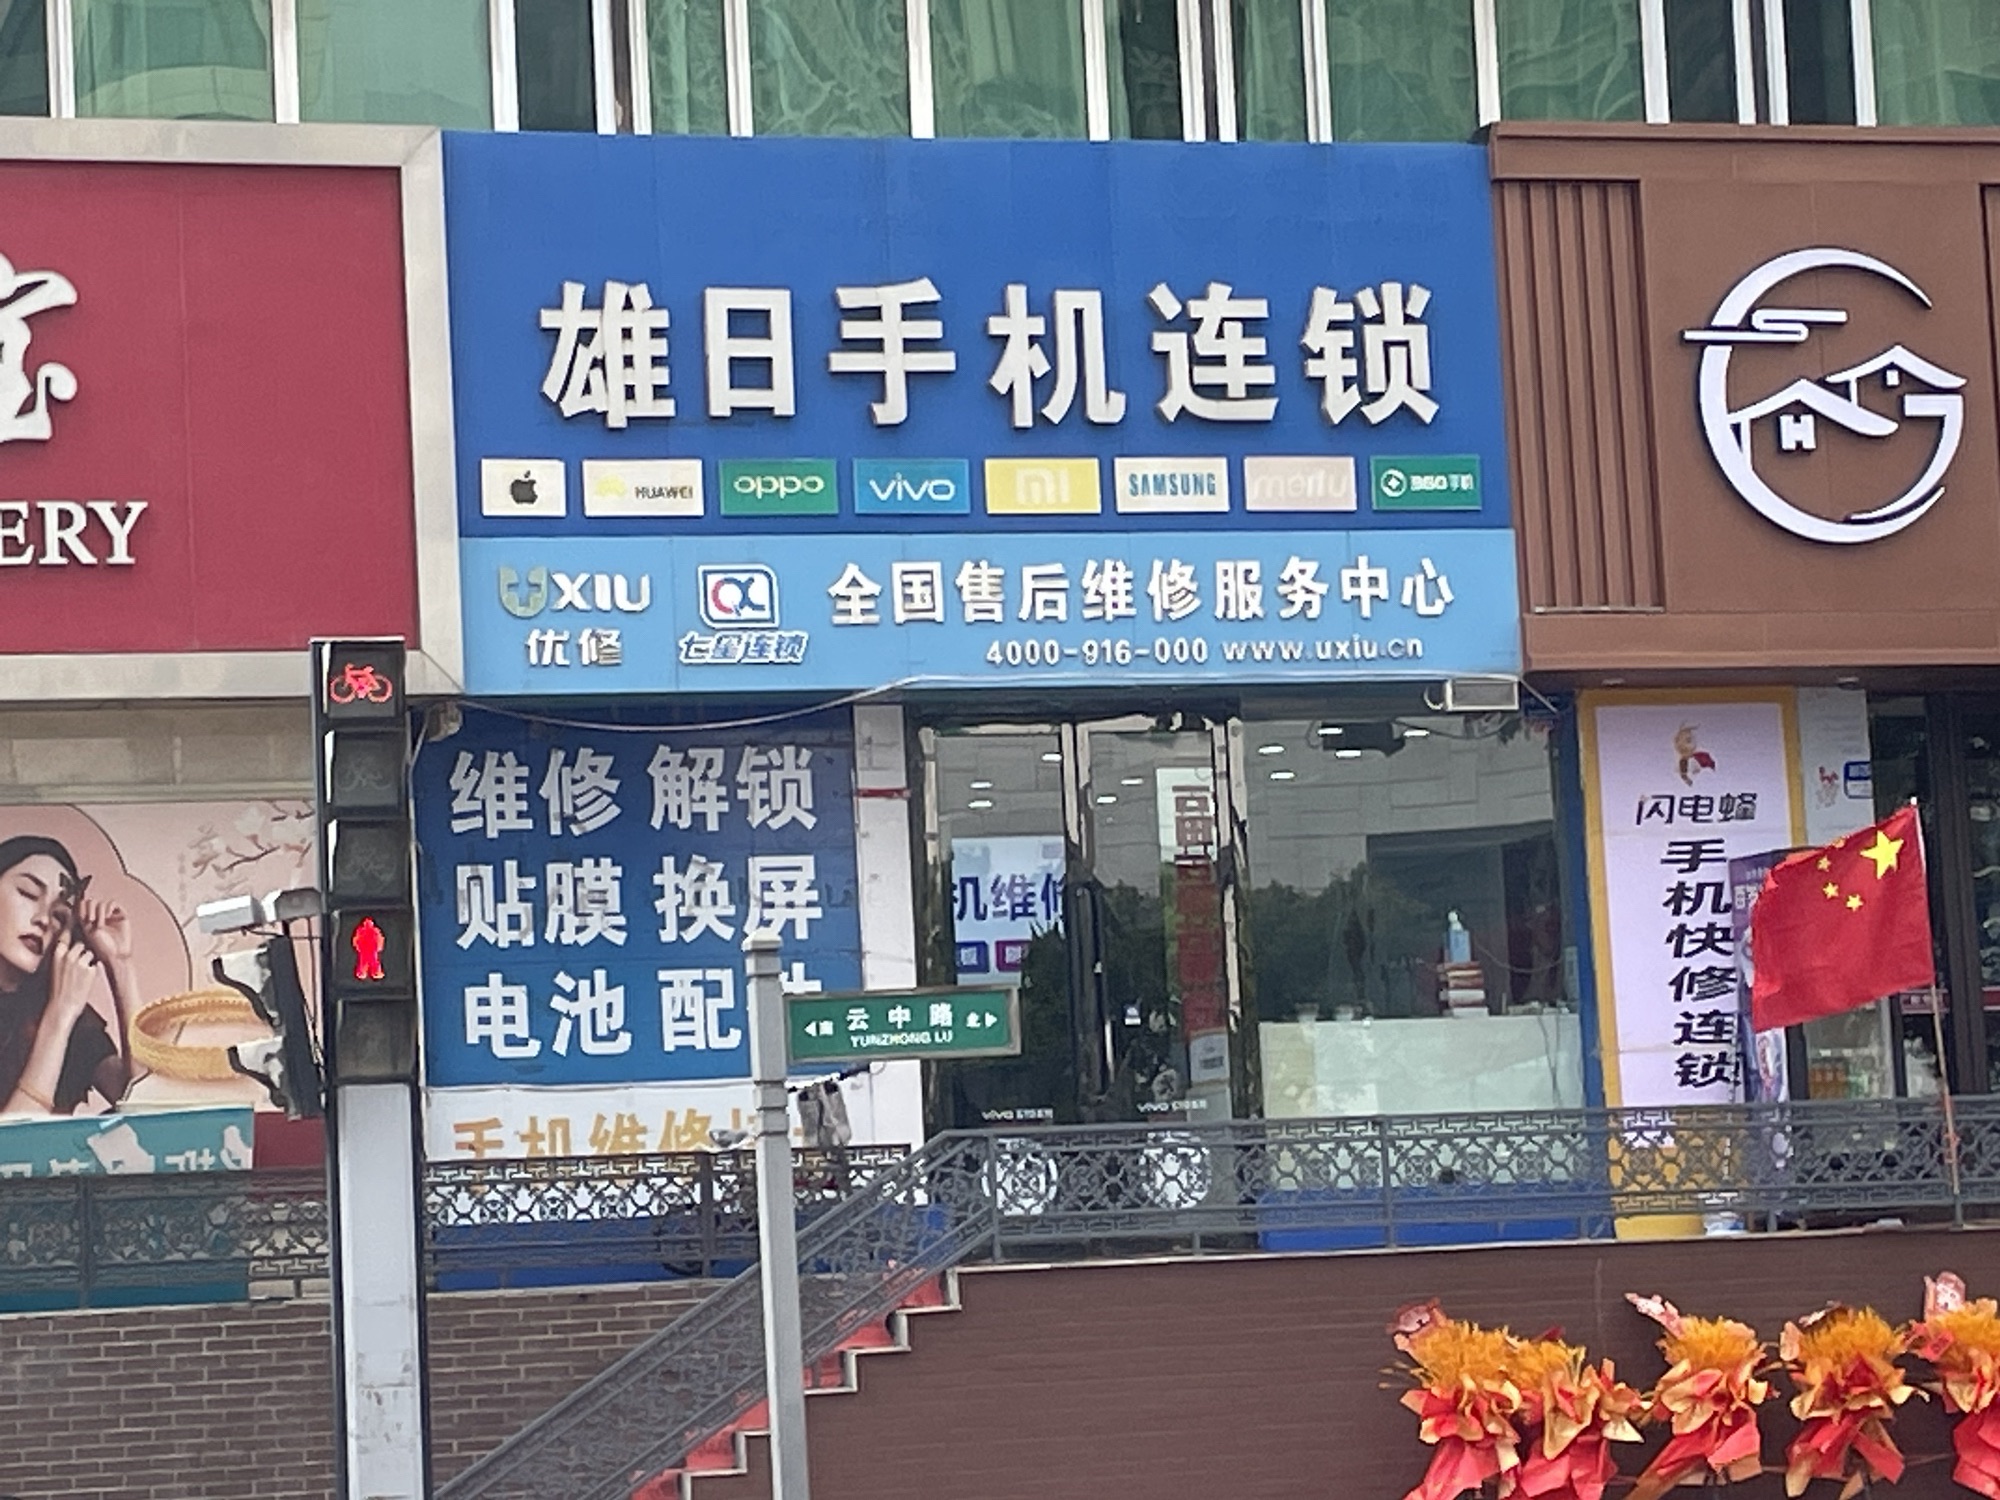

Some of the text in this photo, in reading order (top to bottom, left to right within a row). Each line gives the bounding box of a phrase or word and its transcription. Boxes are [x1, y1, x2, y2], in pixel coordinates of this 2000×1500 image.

[539, 277, 1440, 430] 雄日手机连锁
[634, 485, 694, 501] HUAWEI
[869, 474, 956, 502] vivo
[1128, 472, 1217, 498] SAMSUNG
[827, 556, 1456, 626] 全国售后维修服务中心
[526, 628, 623, 667] 优修
[986, 632, 1425, 666] 4000-916-000 www.uxiu.cn
[448, 743, 818, 838] 维修 解锁
[454, 854, 823, 950] 贴膜 换屏
[1660, 837, 1743, 1090] 手机快修连锁
[463, 968, 633, 1060] 电池
[846, 1003, 953, 1031] 云中路
[850, 1030, 953, 1048] YUNZHONG LU
